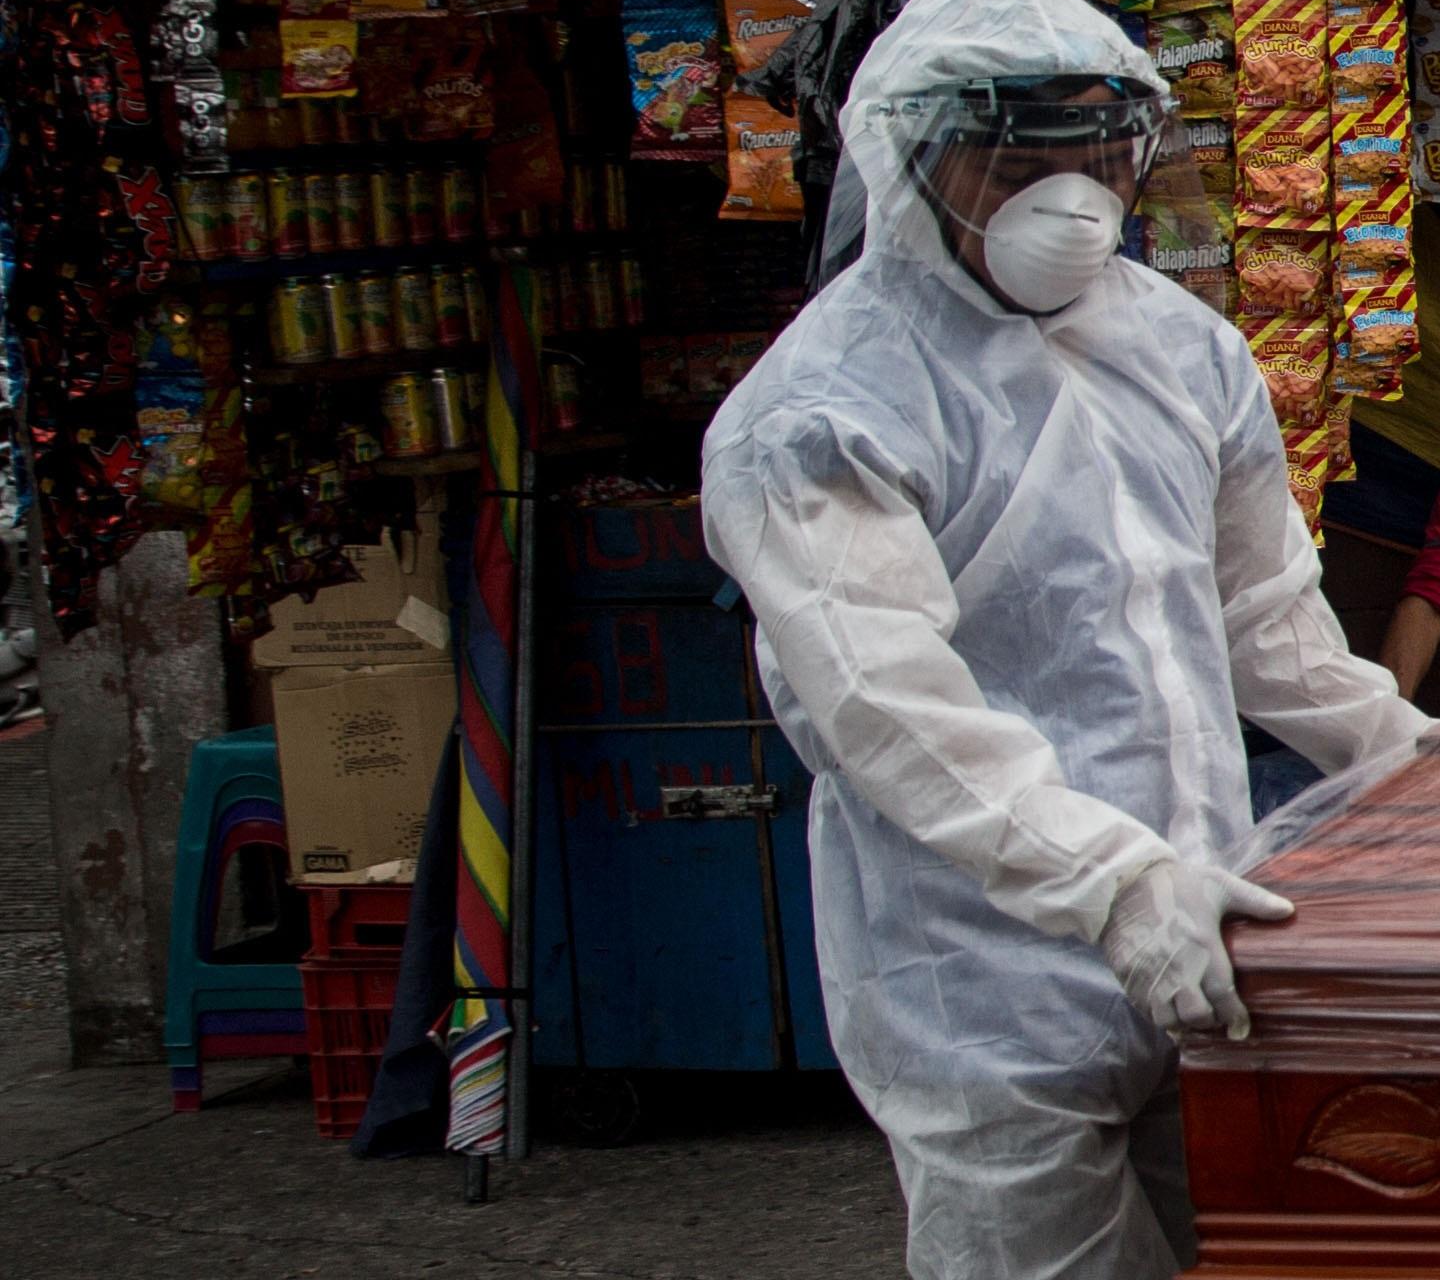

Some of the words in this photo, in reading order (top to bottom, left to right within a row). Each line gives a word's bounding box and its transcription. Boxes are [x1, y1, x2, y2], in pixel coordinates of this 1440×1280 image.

[1264, 21, 1298, 33] DIANA
[1154, 39, 1223, 69] Jalapeños
[1244, 37, 1319, 60] churritos
[1190, 65, 1224, 77] DIANA
[422, 79, 485, 99] PALITOS
[1357, 123, 1384, 134] DIANA
[1267, 134, 1301, 145] DIANA
[1246, 149, 1320, 171] churritos
[1361, 212, 1388, 222] DIANA
[1264, 233, 1300, 245] DIANA
[1243, 248, 1319, 272] churritos
[1368, 298, 1396, 308] DIANA
[1265, 342, 1301, 354] DIANA
